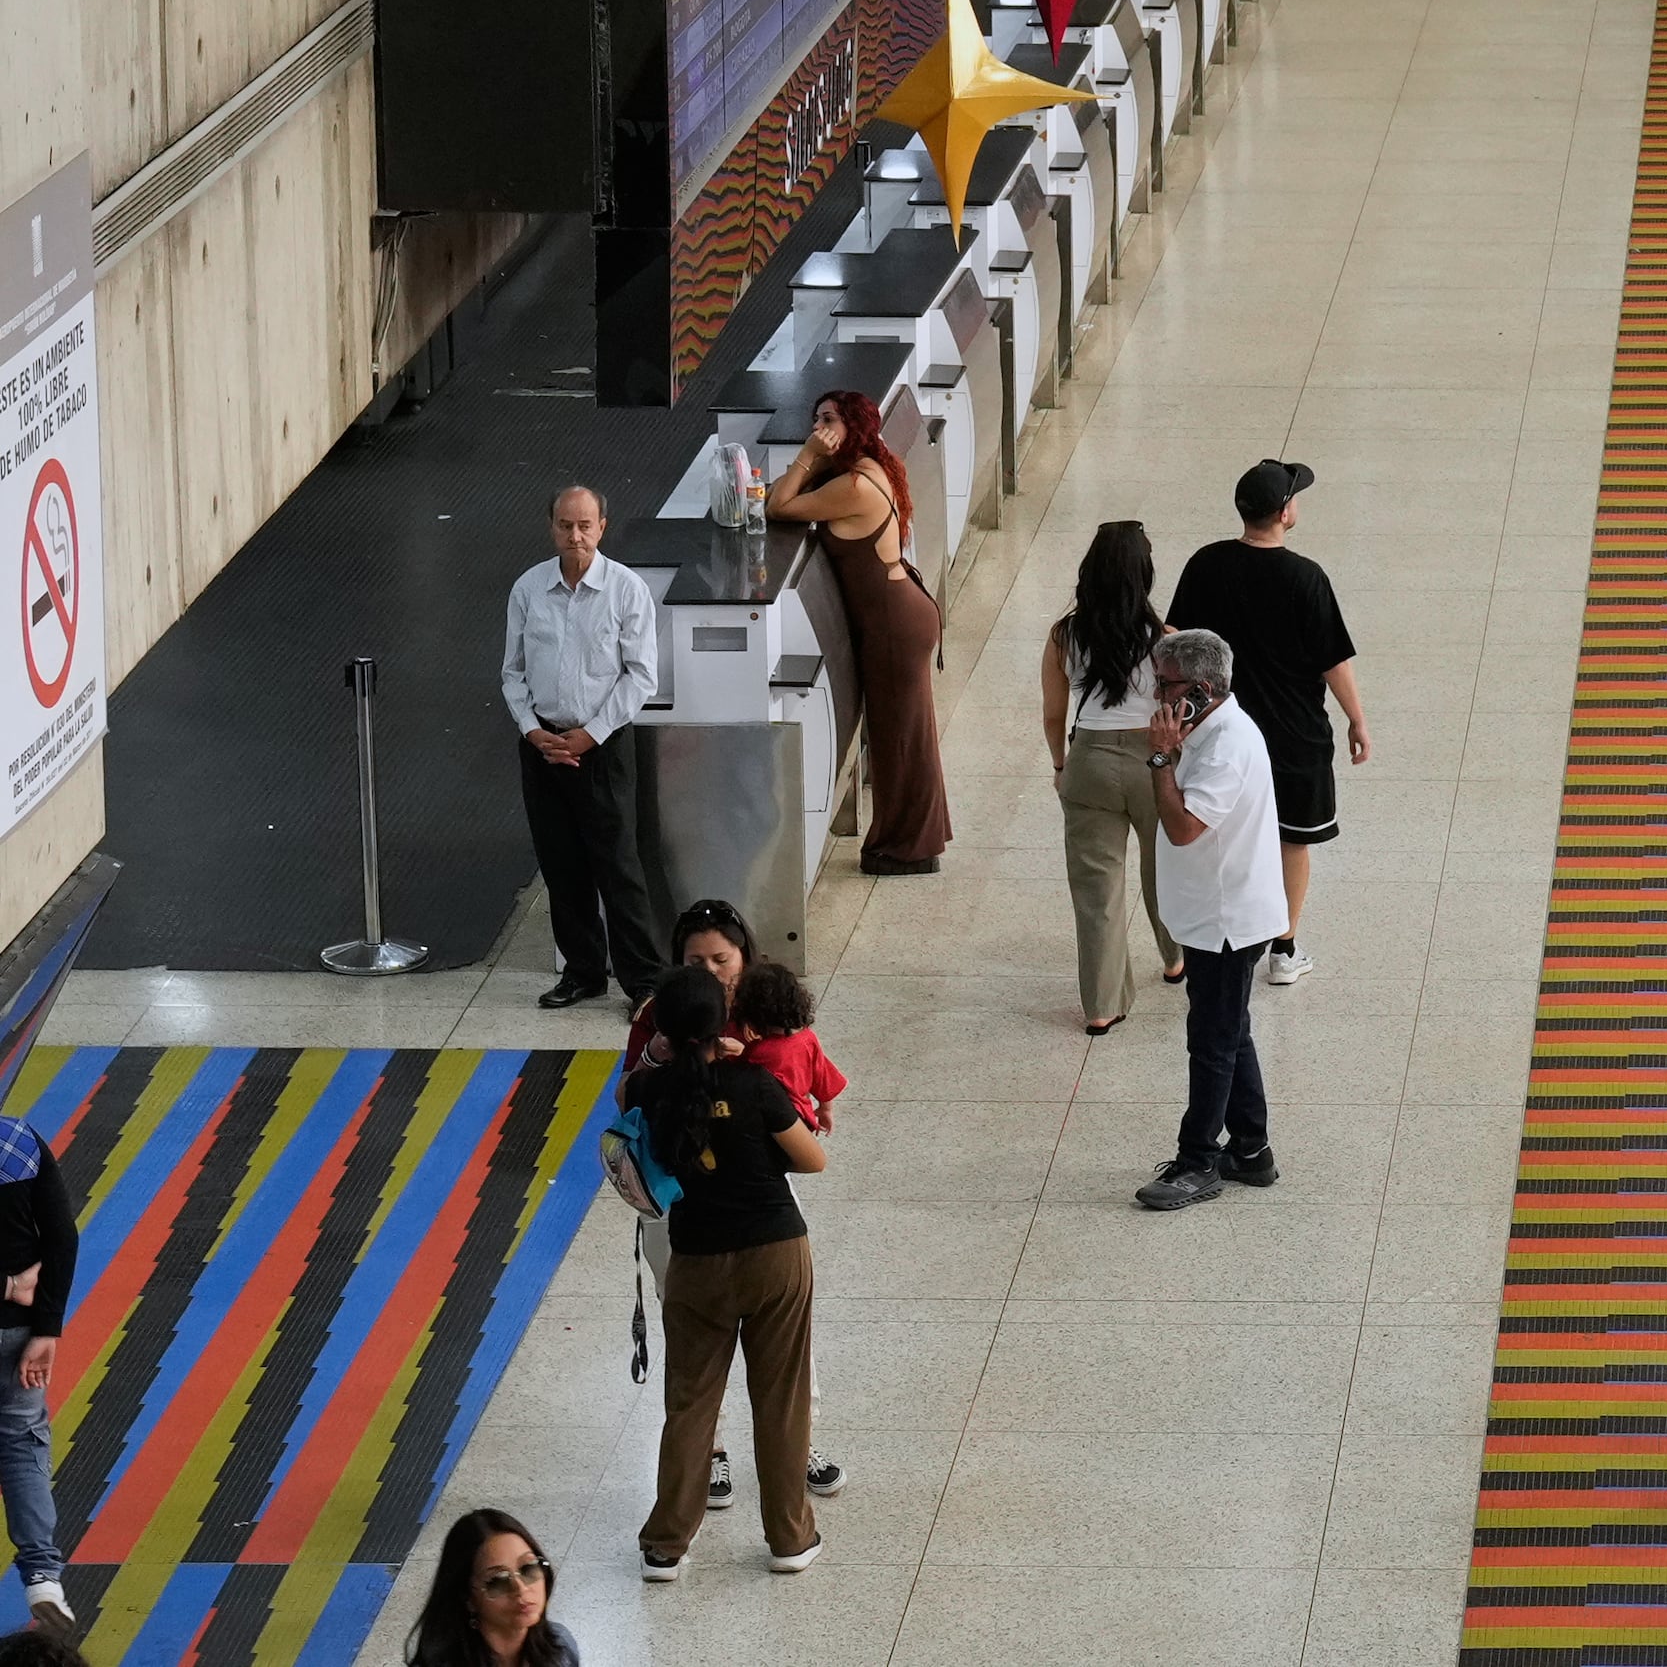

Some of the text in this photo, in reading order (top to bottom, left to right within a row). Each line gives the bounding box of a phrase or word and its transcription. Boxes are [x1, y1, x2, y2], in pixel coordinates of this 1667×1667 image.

[20, 367, 31, 397] ES
[32, 354, 45, 384] UN
[45, 320, 84, 375] AMBIENTE
[0, 383, 87, 481] DE HUMO DE TABACO
[18, 366, 69, 431] 100% LIBRE
